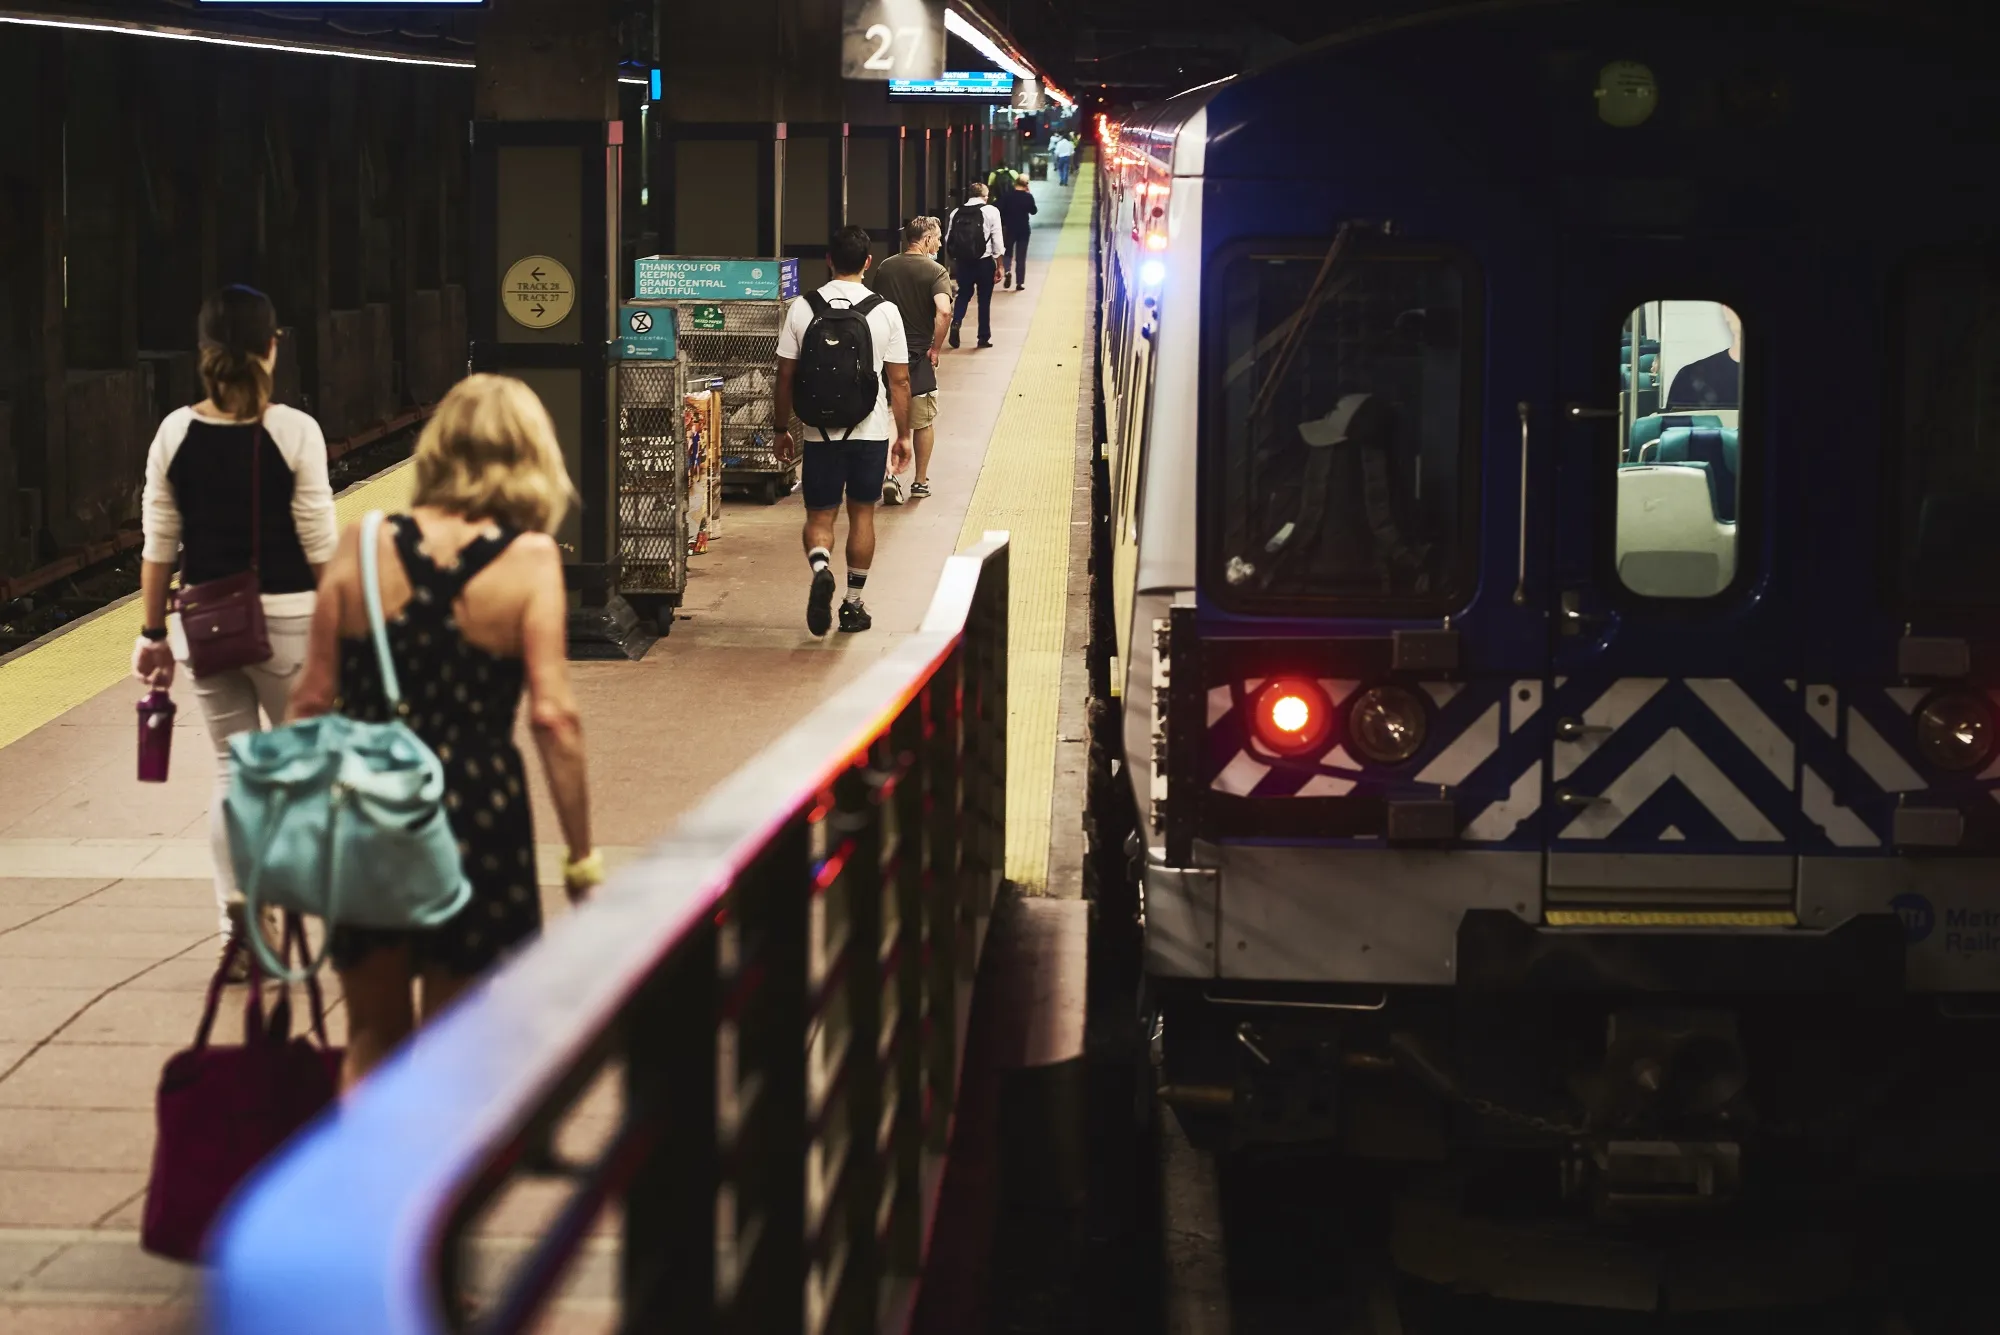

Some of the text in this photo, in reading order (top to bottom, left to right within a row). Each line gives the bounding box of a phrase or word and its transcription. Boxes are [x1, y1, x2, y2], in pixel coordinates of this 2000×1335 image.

[863, 23, 924, 70] 27
[1018, 91, 1039, 107] 27
[639, 263, 721, 272] THANK YOU FOR
[639, 271, 685, 279] KEEPING
[517, 282, 549, 290] TRACK
[639, 279, 726, 288] GRAND CENTRAL
[639, 287, 700, 295] BEAUTIFUL.
[517, 294, 560, 302] TRACK 27
